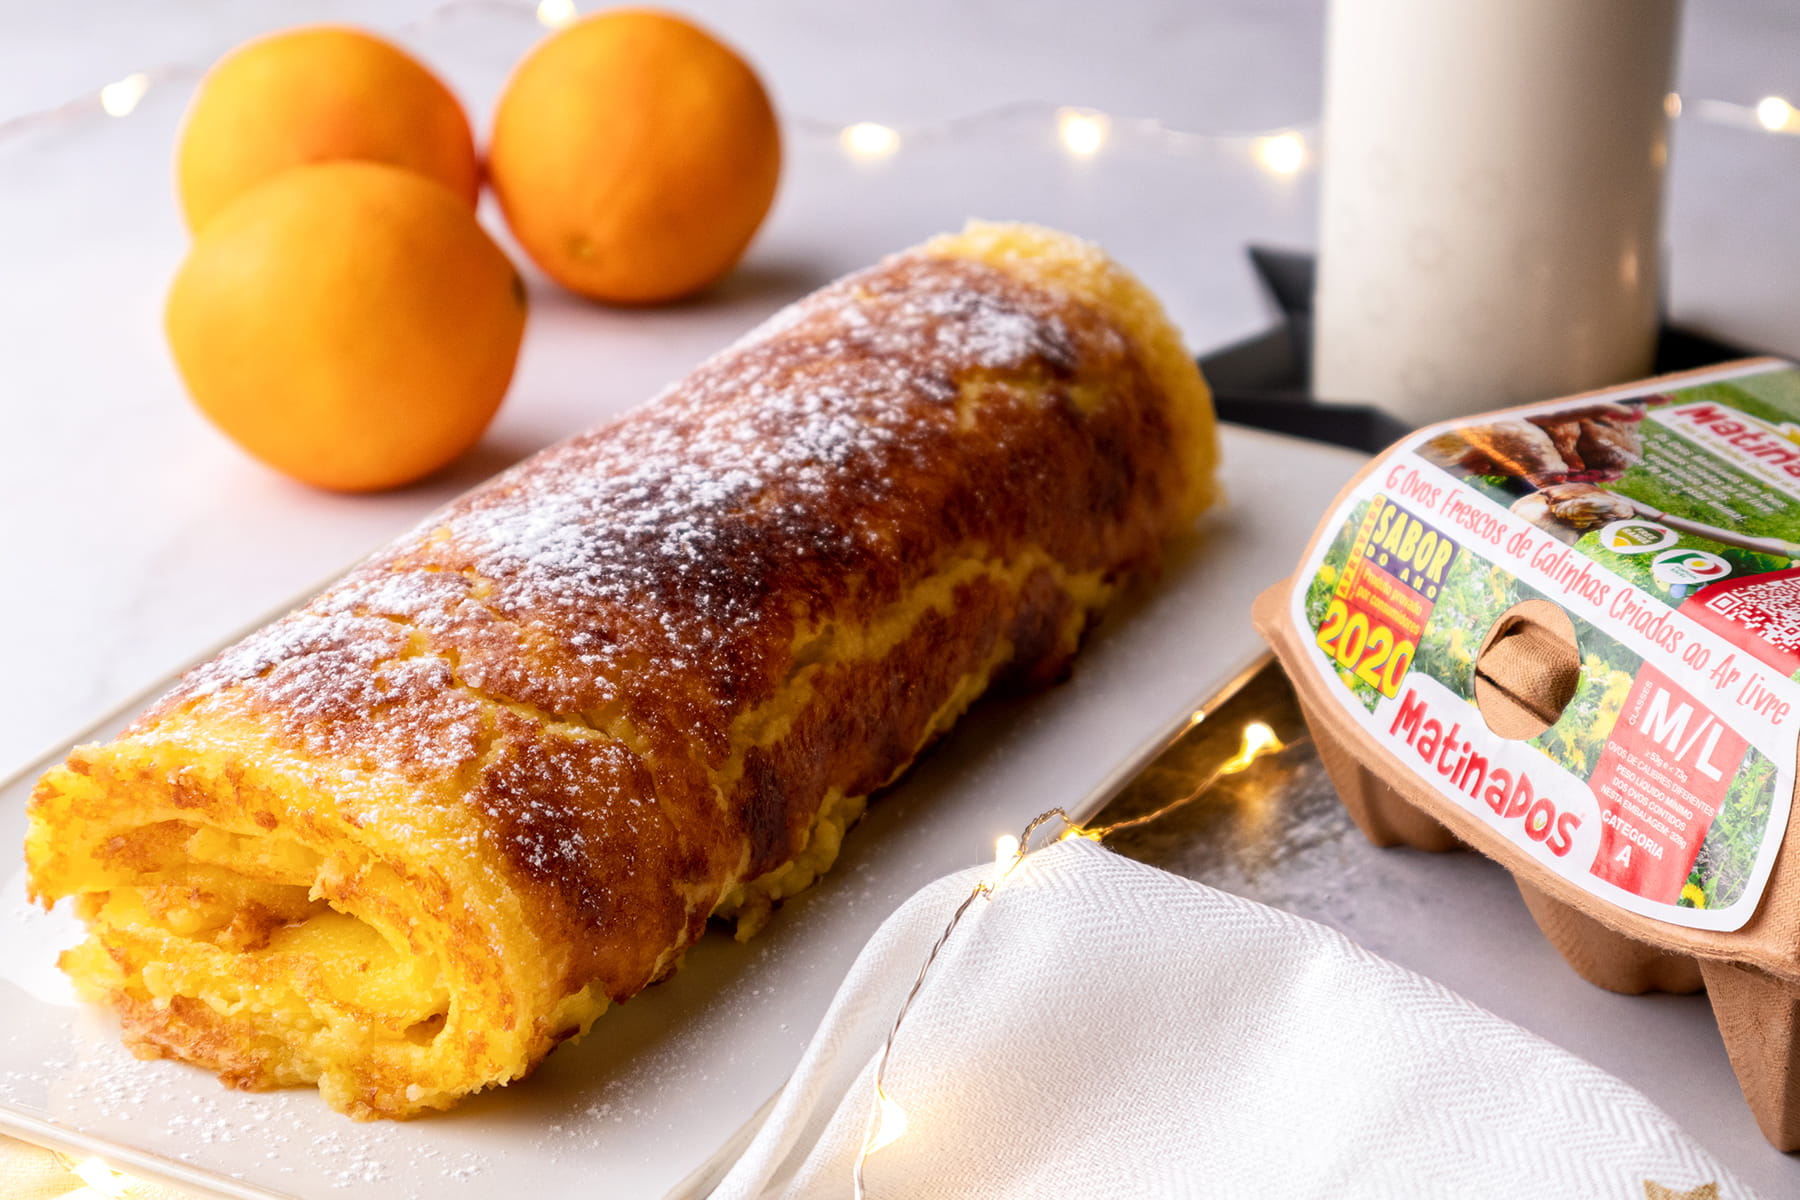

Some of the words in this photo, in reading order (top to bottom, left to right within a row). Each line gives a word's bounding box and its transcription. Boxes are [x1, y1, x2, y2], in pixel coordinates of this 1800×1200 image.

[1340, 497, 1383, 594] APROVADO
[1366, 543, 1389, 566] DO
[1400, 568, 1437, 599] ANO
[1372, 504, 1453, 584] SABOR
[1385, 464, 1407, 490] 6
[1400, 470, 1442, 509] Ovos
[1440, 488, 1508, 545] Frescos
[1506, 526, 1533, 559] de
[1530, 542, 1610, 607] Galinhas
[1609, 587, 1685, 654] Criadas
[1682, 642, 1711, 671] ao
[1709, 653, 1741, 690] Ar
[1736, 673, 1791, 725] Livre
[1316, 599, 1417, 700] 2020
[1639, 687, 1724, 782] M/L
[1600, 784, 1623, 804] NESTA
[1608, 741, 1628, 760] OVOS
[1627, 752, 1640, 767] DE
[1638, 758, 1673, 789] CALIBRES
[1671, 781, 1715, 817] DIFERENTES
[1612, 776, 1629, 792] DOS
[1627, 786, 1649, 806] OVOS
[1647, 800, 1687, 831] CONTIDOS
[1615, 763, 1636, 783] PESO
[1635, 774, 1665, 801] LÍQUIDO
[1664, 794, 1694, 820] MÍNIMO
[1601, 809, 1664, 861] CATEGORIA
[1615, 845, 1632, 868] A
